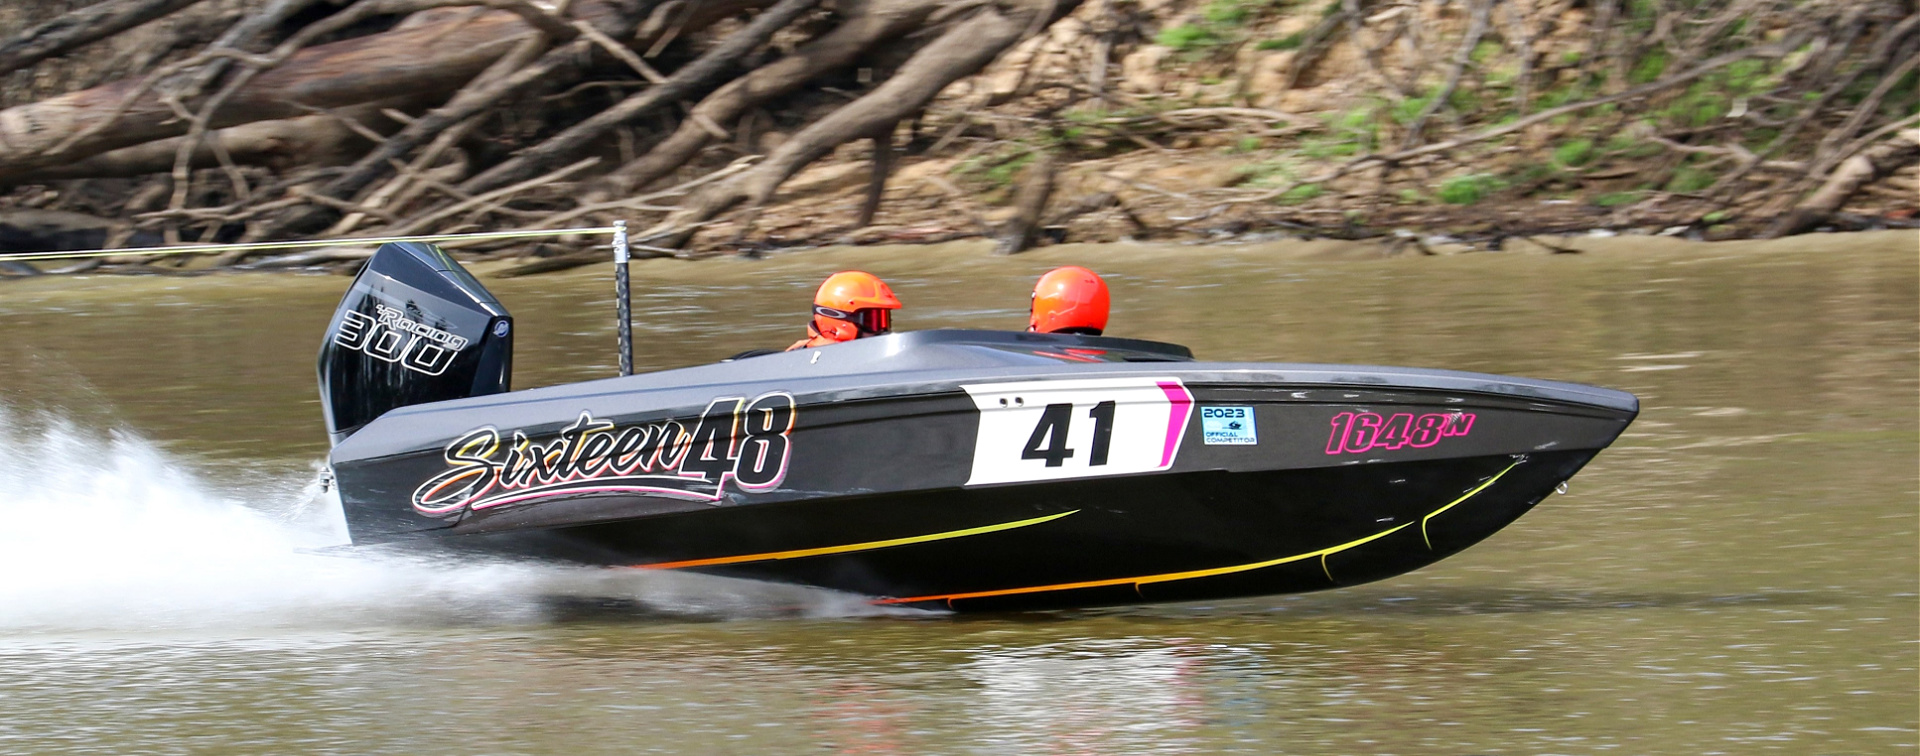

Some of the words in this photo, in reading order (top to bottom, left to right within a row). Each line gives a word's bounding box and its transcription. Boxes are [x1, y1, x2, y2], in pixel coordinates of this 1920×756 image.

[334, 309, 459, 376] 300
[377, 306, 469, 352] Racing
[1021, 400, 1116, 468] 41
[1203, 408, 1245, 418] 2023
